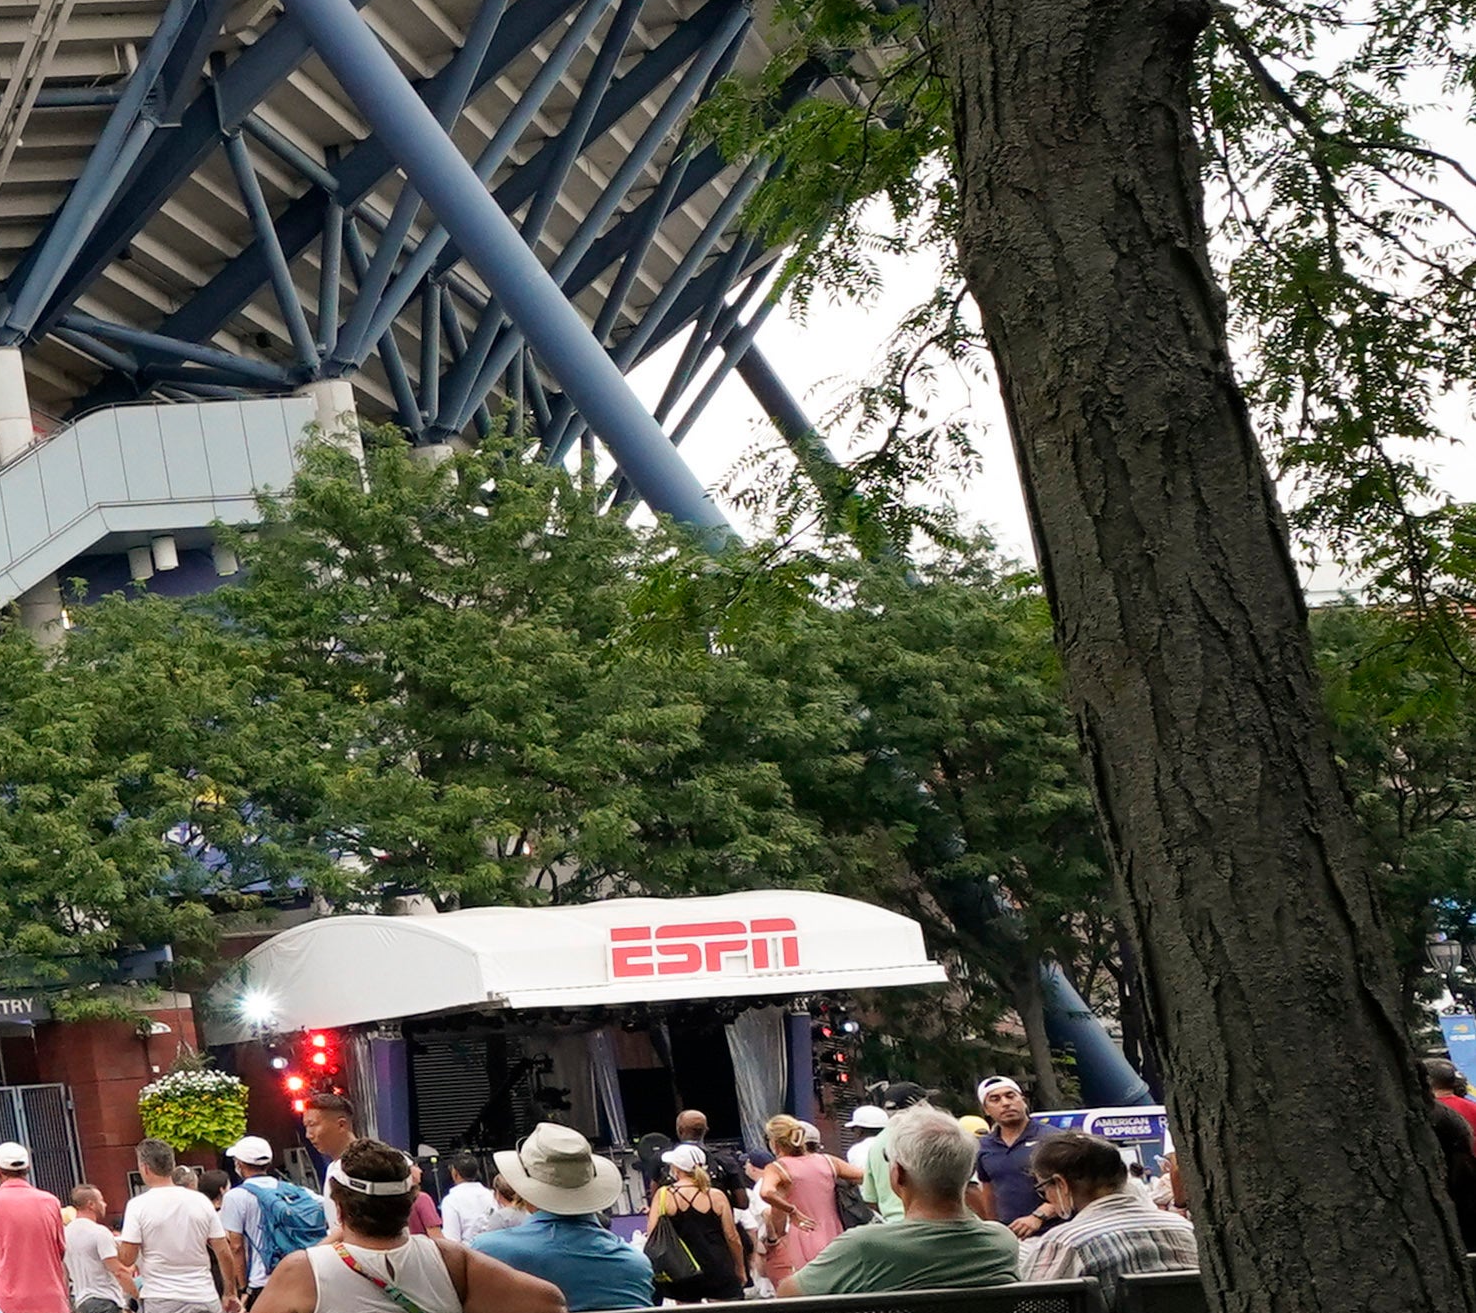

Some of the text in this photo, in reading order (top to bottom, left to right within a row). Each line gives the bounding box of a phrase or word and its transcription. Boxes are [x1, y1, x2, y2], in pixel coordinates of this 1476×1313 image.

[610, 917, 800, 979] ESPN
[1094, 1117, 1149, 1128] AMERICAN
[1103, 1126, 1152, 1135] EXPRESS
